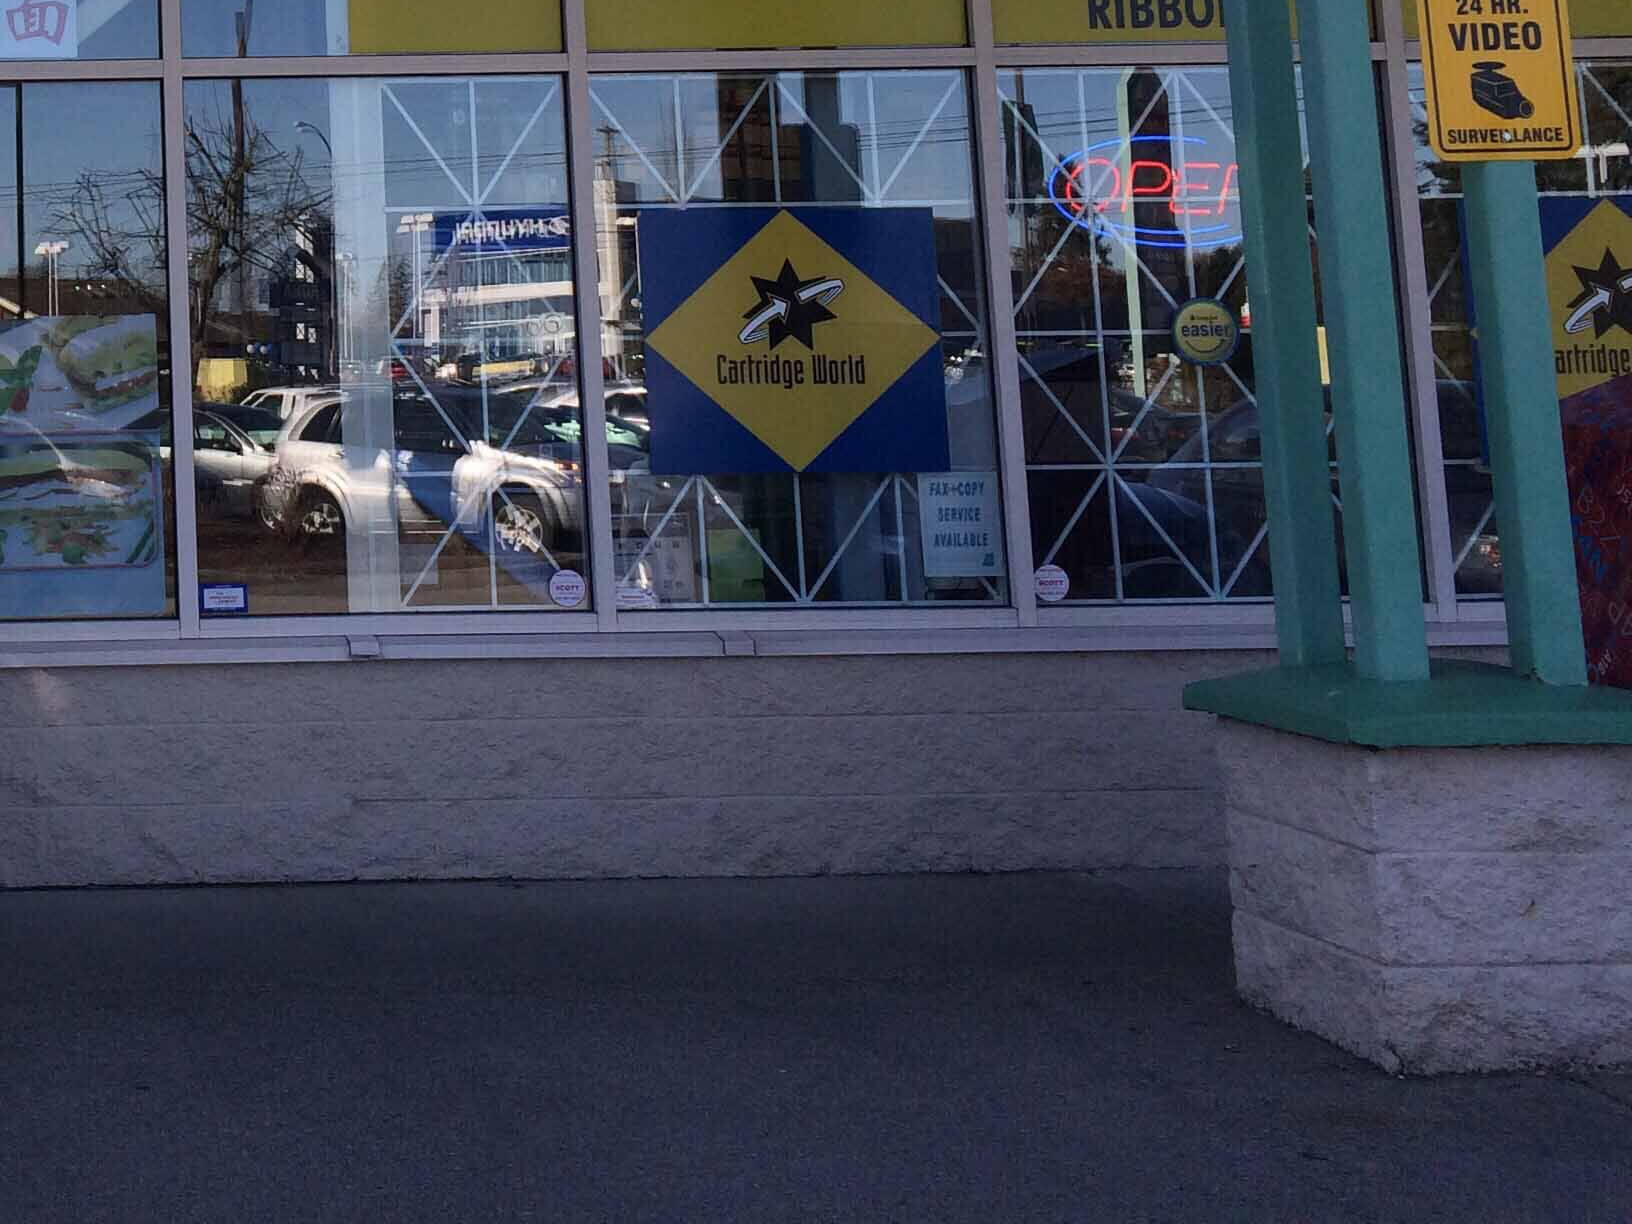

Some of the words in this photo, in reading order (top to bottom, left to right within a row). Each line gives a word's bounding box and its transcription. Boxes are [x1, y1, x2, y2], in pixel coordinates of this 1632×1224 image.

[1448, 21, 1543, 52] VIDEO
[1447, 126, 1565, 145] SURVEILLANCE
[716, 353, 804, 390] Cartridge
[812, 354, 866, 386] World
[1555, 343, 1631, 377] artridge
[933, 532, 990, 547] AVAILABLE
